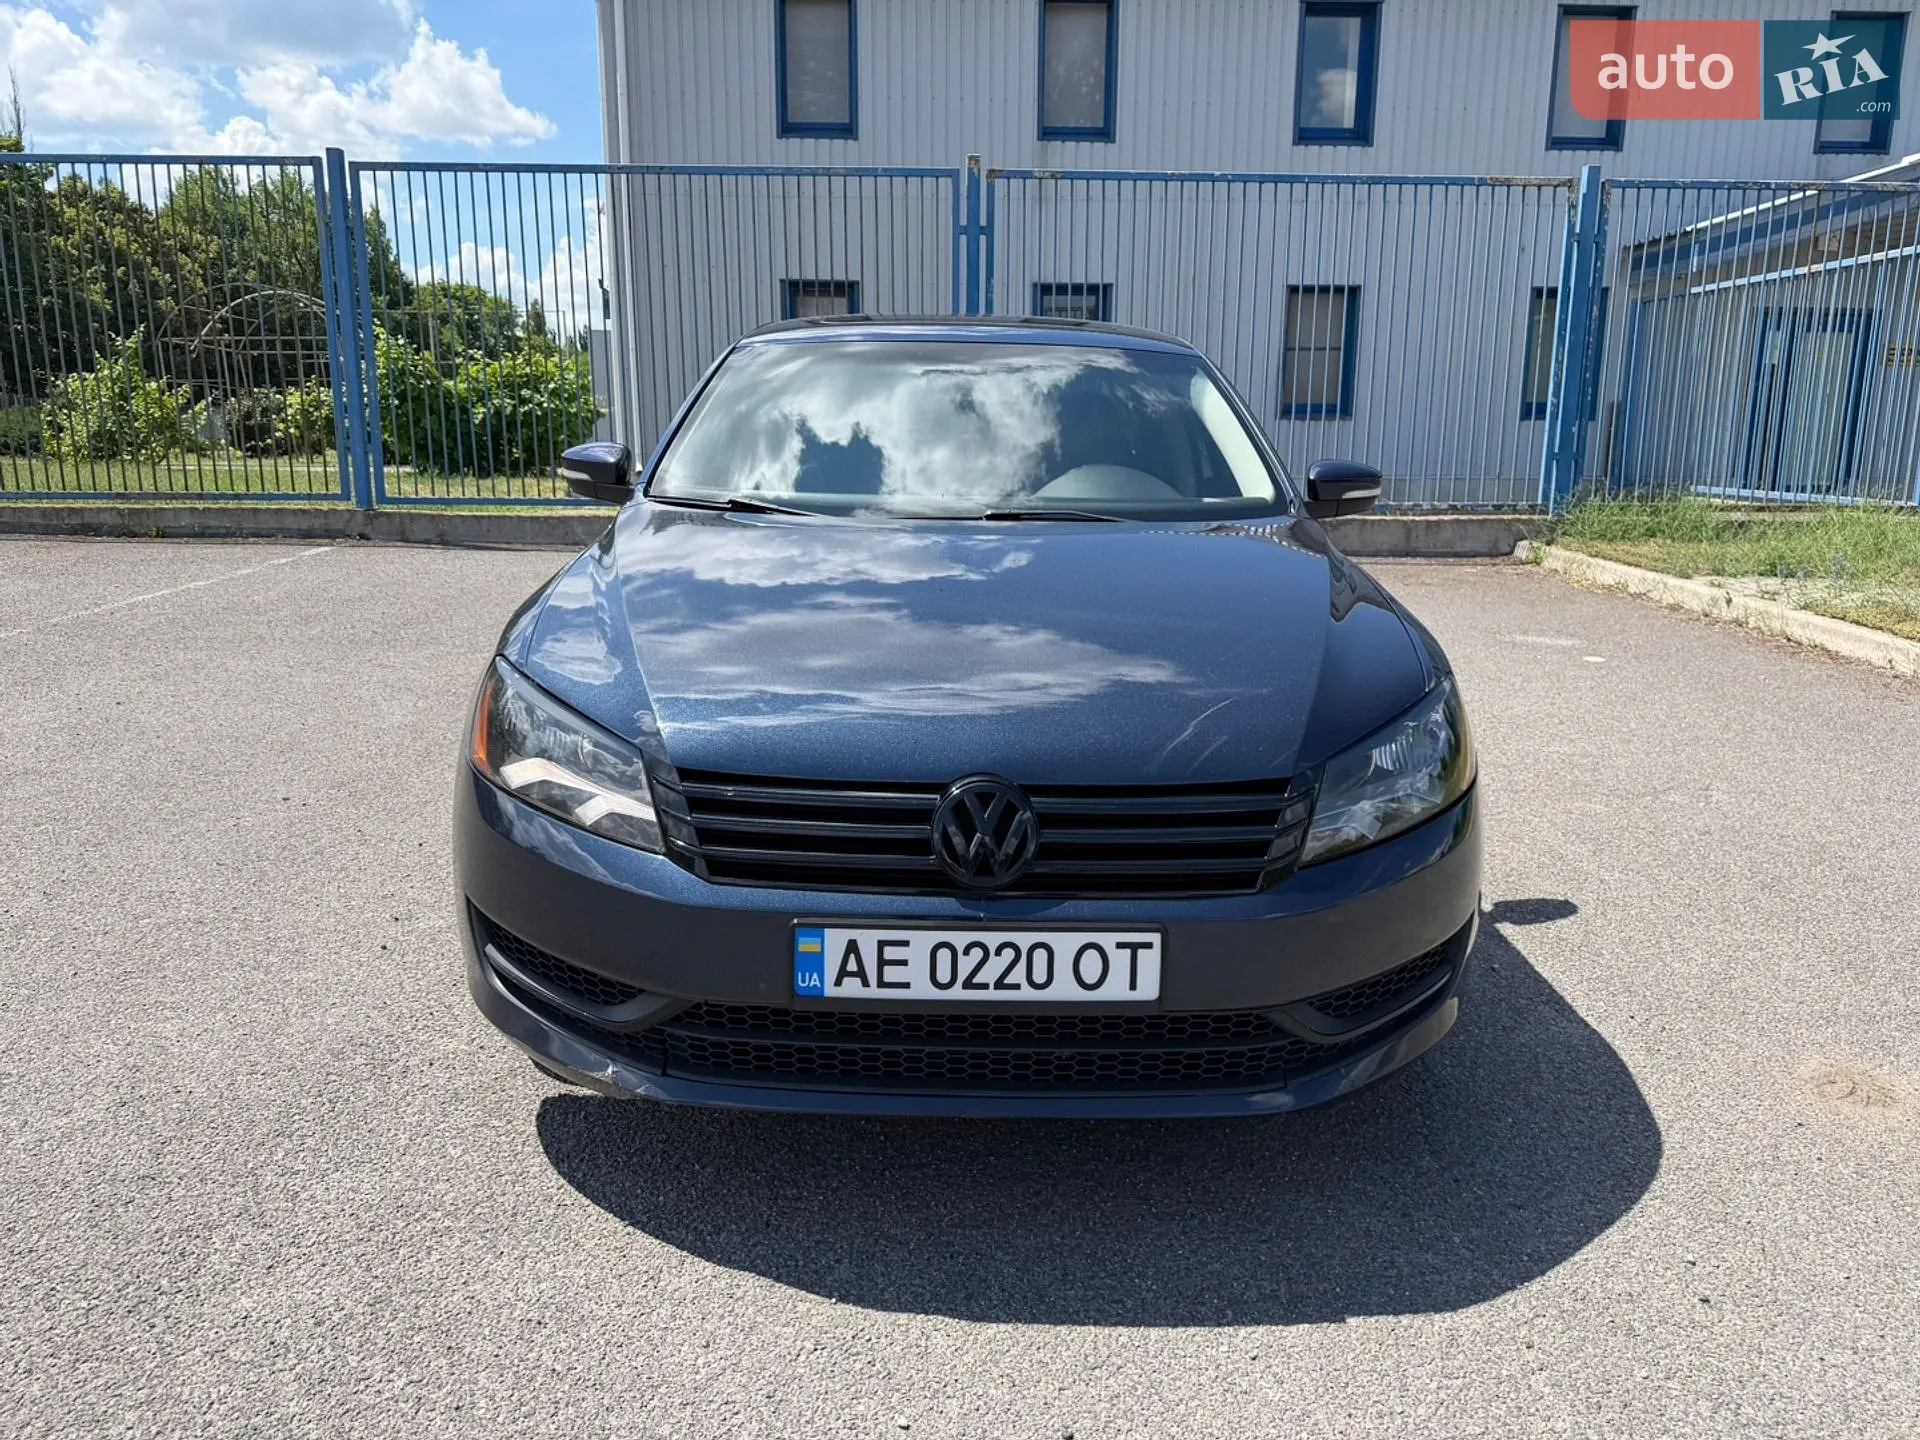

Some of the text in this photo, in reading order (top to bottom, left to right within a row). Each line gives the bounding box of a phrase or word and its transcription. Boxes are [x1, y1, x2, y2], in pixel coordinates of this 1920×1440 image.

[797, 971, 821, 988] UA
[833, 938, 1154, 992] AE 0220 OT
